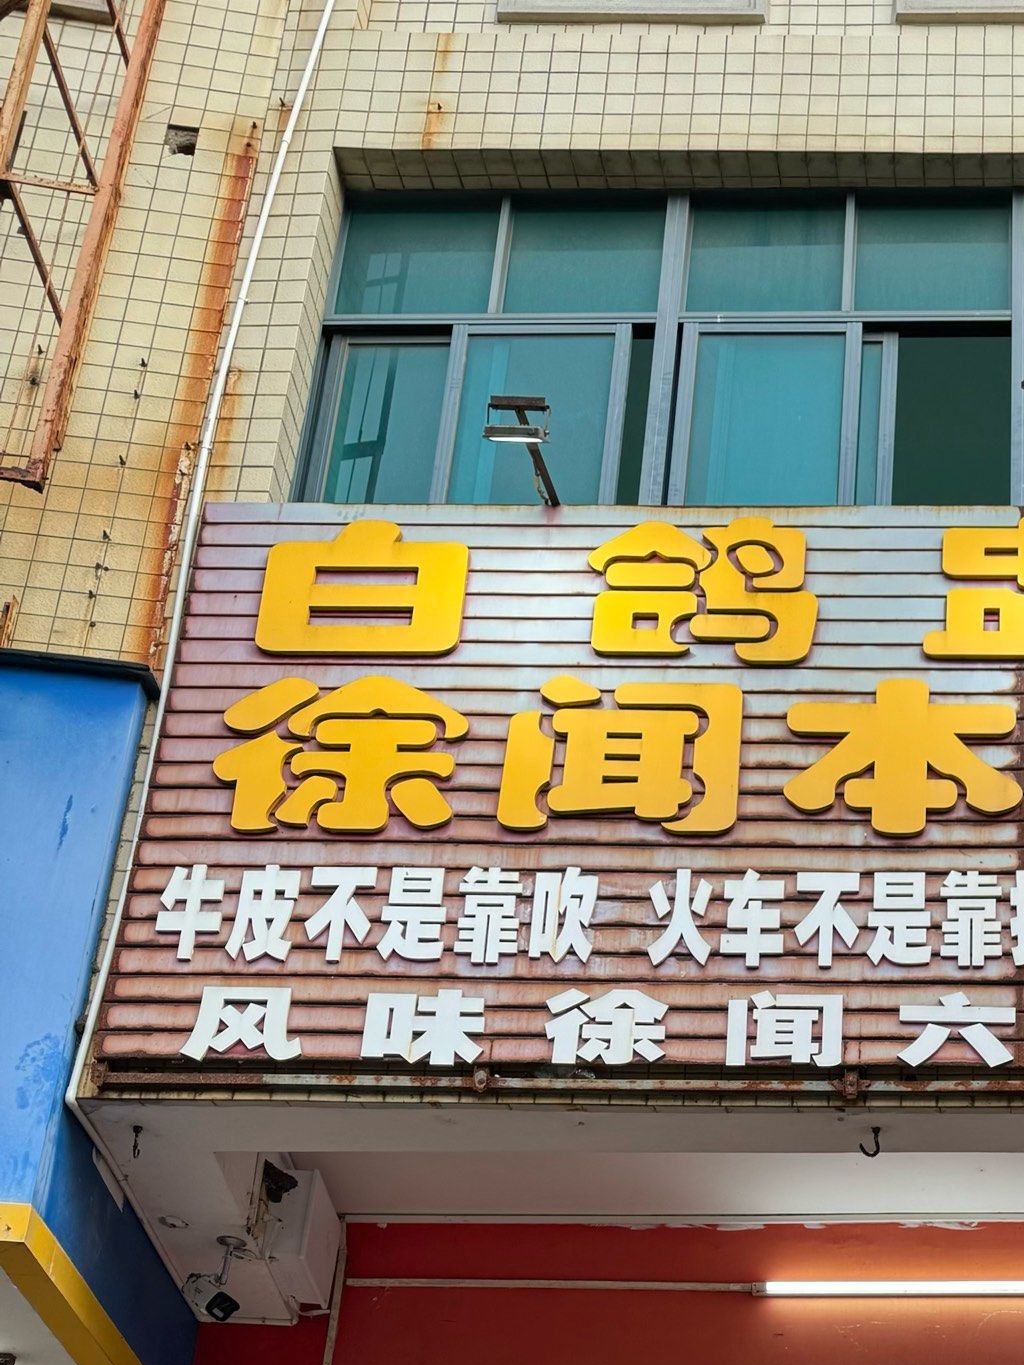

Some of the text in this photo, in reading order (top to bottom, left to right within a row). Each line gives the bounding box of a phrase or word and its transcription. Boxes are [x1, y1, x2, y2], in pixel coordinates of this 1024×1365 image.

[155, 865, 600, 964] 牛皮不是靠吹
